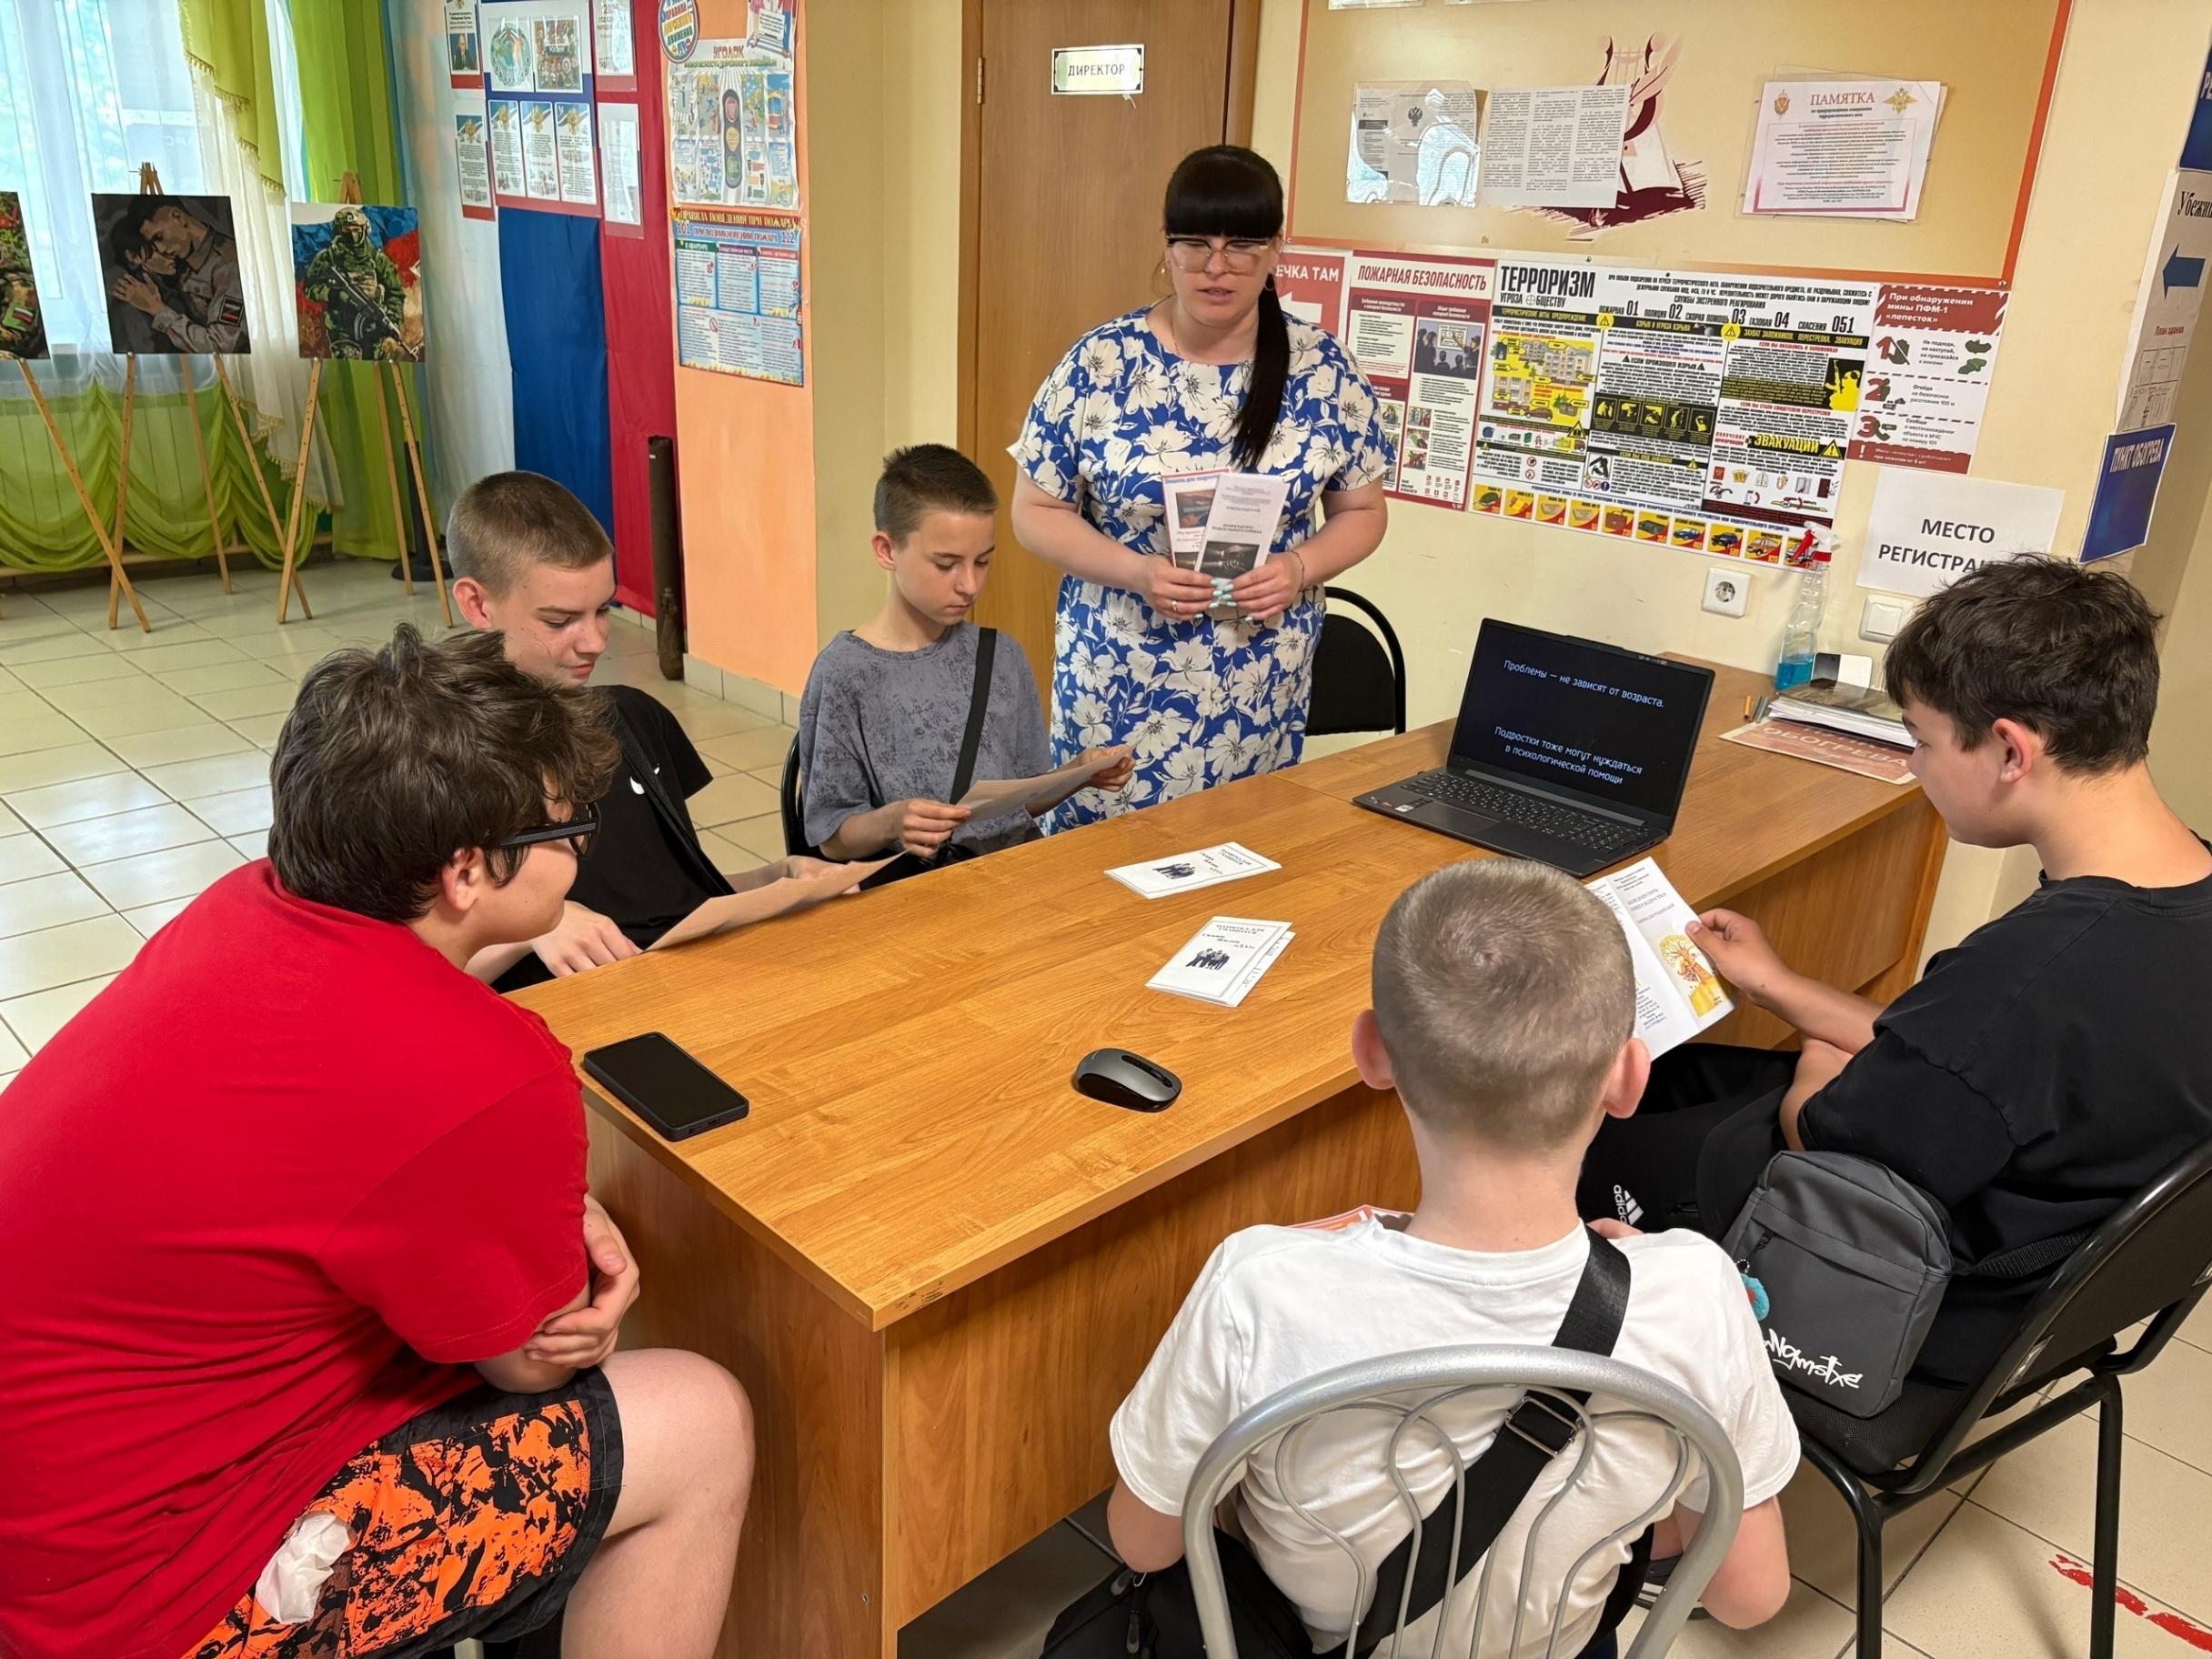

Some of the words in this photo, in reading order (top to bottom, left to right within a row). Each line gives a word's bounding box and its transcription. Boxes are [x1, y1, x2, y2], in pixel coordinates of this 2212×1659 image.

[713, 45, 744, 59] УГОЛОК
[1068, 64, 1125, 76] ДИРЕКТОР
[1810, 92, 1875, 106] ПАМЯТКА
[2177, 190, 2212, 218] Убежи
[677, 223, 690, 234] 101
[781, 231, 795, 244] 112
[1275, 264, 1309, 279] ЕЧКА
[1312, 266, 1339, 282] ТАМ
[1358, 265, 1411, 284] ПОЖАРНАЯ
[1412, 269, 1487, 291] БЕЗОПАСНОСТЬ
[1501, 266, 1595, 298] ТЕРРОРИЗМ
[1501, 293, 1523, 305] УГРОЗА
[1674, 295, 1694, 304] СЛУЖБЫ
[1695, 297, 1728, 306] ЭКСТРЕННОГО
[1729, 298, 1766, 309] РЕАГИРОВАНИЯ
[1887, 304, 1914, 312] мины
[1915, 305, 1948, 314] ПФМ-1
[1889, 292, 1908, 302] При
[1909, 296, 1974, 306] обнаружении
[1598, 305, 1624, 315] ПОЖАРНАЯ
[1626, 300, 1639, 316] 01
[1644, 308, 1666, 318] ПОЛИЦИЯ
[1668, 304, 1683, 318] 02
[1685, 312, 1704, 321] СКОРАЯ
[1705, 313, 1730, 323] ПОМОЩЬ
[1732, 308, 1746, 325] 03
[1749, 317, 1773, 327] ГАЗОВАЯ
[1774, 312, 1790, 328] 04
[1798, 320, 1826, 331] СПАСЕНИЯ
[1832, 316, 1855, 334] 051
[1885, 314, 1938, 323] «лепесток»
[1744, 328, 1761, 337] ЗАХВАТ
[1835, 336, 1863, 346] ЭВАКУАЦИЯ
[1875, 336, 1892, 359] 1
[1865, 377, 1884, 402] 2
[1910, 397, 1939, 406] расстояние
[1856, 416, 1876, 438] 3
[1755, 434, 1820, 453] ЭВАКУАЦИИ
[2109, 446, 2135, 473] ПУНКТ
[2132, 437, 2165, 468] ОБОГРЕВА
[1921, 518, 1996, 544] МЕСТО
[1878, 544, 1986, 573] РЕГИСТРА
[1503, 660, 1547, 679] Проблемы
[1560, 675, 1570, 684] не
[1573, 678, 1607, 693] зависят
[1609, 687, 1619, 696] от
[1622, 689, 1664, 708] возраста.
[1494, 727, 1539, 747] Подростки
[1542, 739, 1563, 753] тоже
[1565, 747, 1592, 761] могут
[1594, 755, 1643, 775] нуждаться
[1764, 728, 1907, 768] ОБОГРЕВА
[1505, 745, 1511, 753] в
[1513, 746, 1586, 774] психологической
[1588, 768, 1623, 785] помощи
[1614, 1184, 1627, 1224] adida
